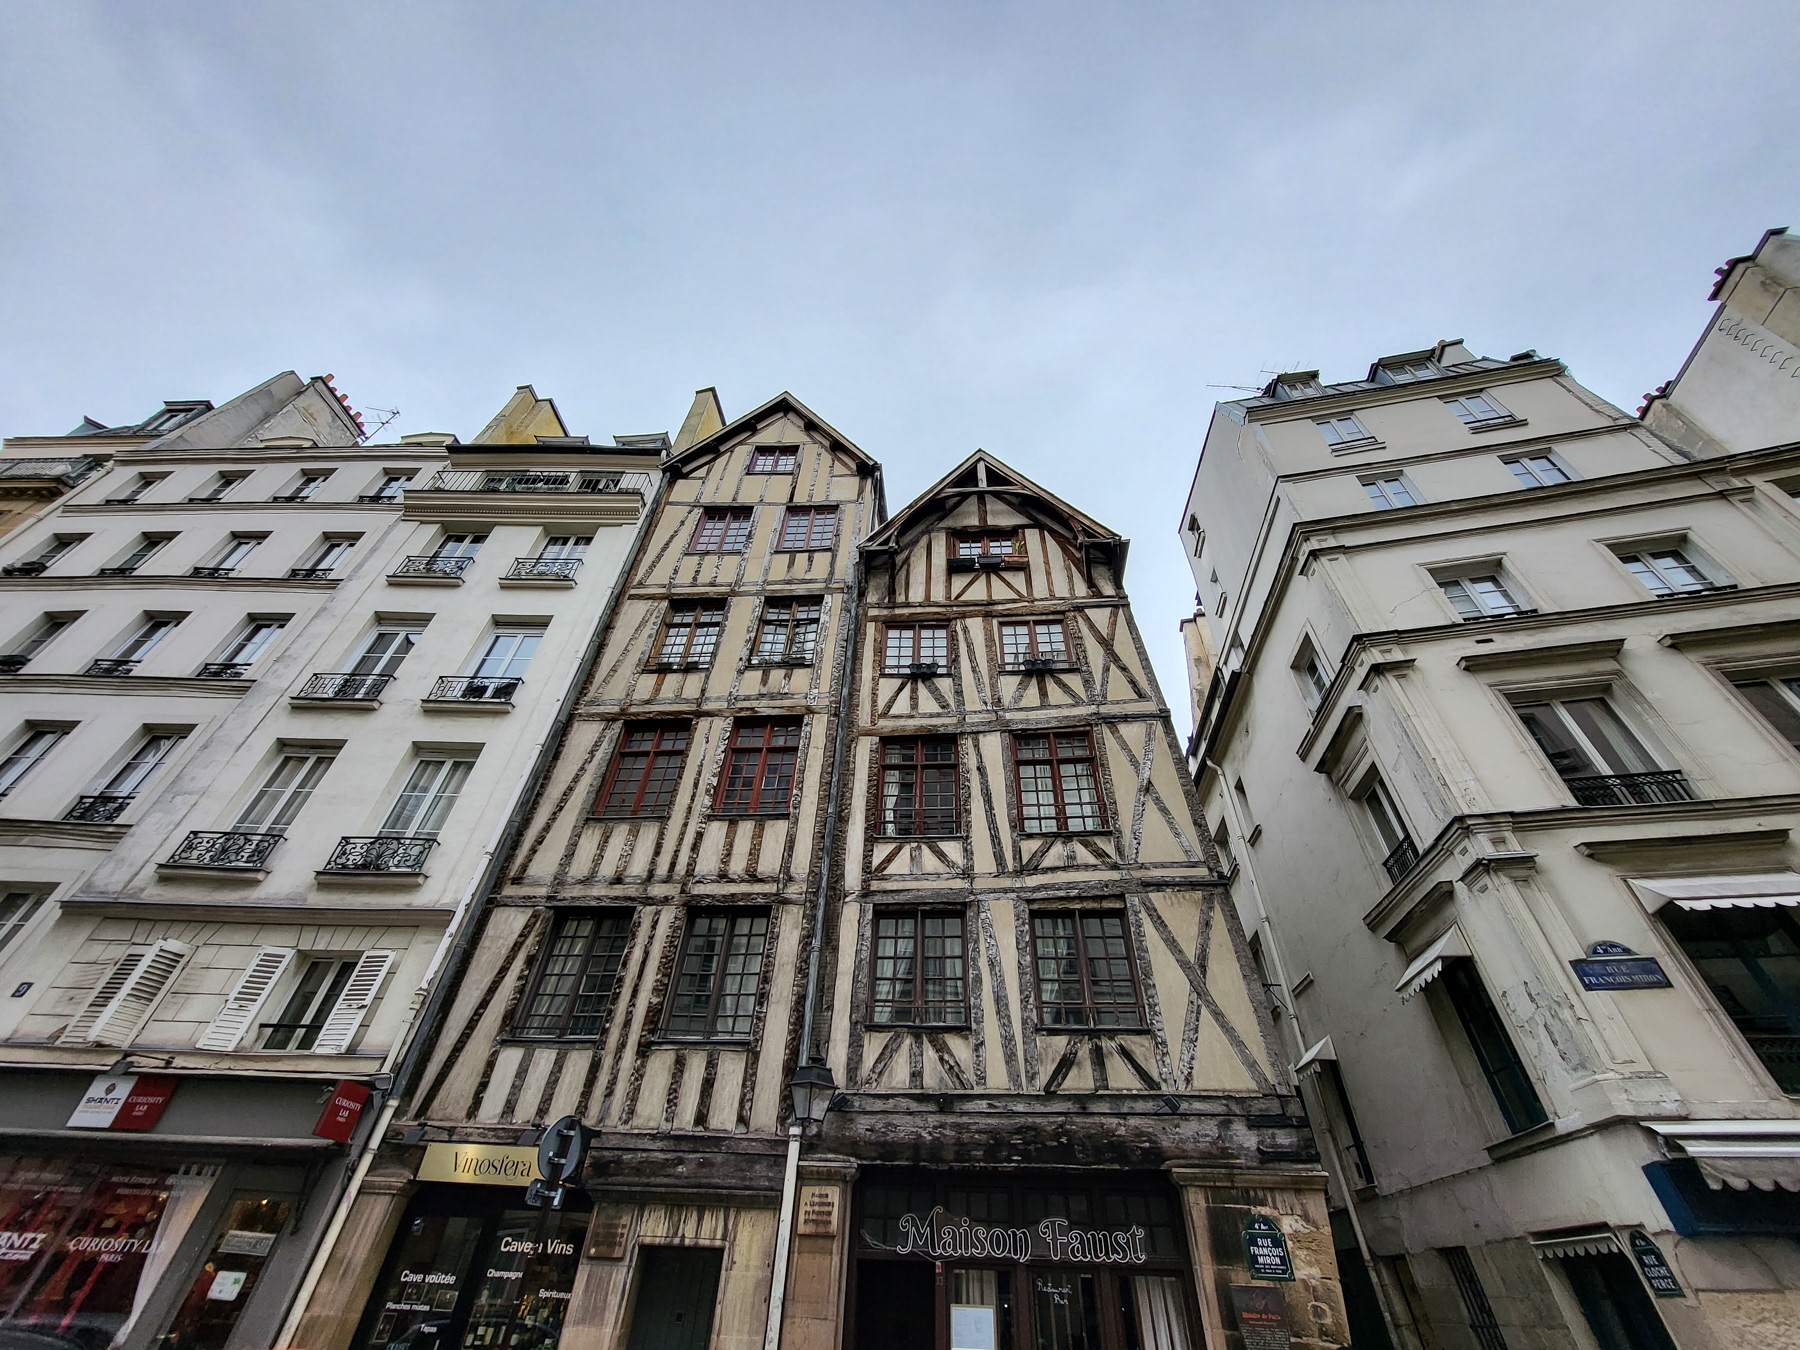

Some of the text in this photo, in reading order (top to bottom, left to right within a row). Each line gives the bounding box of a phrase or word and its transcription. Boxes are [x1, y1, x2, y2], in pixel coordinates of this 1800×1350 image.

[1606, 965, 1630, 974] RUE
[1583, 974, 1664, 984] FRANÇOIS MIRON
[15, 984, 28, 996] 9
[85, 1096, 122, 1105] SHANTI
[128, 1095, 165, 1104] CURIOSITY
[335, 1096, 362, 1111] CURIOSITY
[339, 1108, 349, 1118] LAB
[453, 1151, 531, 1181] Vinosfera
[897, 1205, 1147, 1264] Maison Faust
[69, 1236, 143, 1252] CURIOSITY
[500, 1237, 531, 1253] Cave
[547, 1238, 574, 1255] Vins
[1257, 1238, 1273, 1247] RUE
[1250, 1246, 1284, 1257] FRANÇOIS
[1257, 1255, 1281, 1265] MIRON
[1642, 1255, 1659, 1265] RUE
[1644, 1266, 1670, 1278] CLOCHE
[400, 1270, 456, 1285] Cave voûtée
[1651, 1279, 1676, 1289] PERCE
[538, 1288, 572, 1300] Spiritueux
[385, 1301, 411, 1311] Planches
[420, 1324, 437, 1334] Tapas
